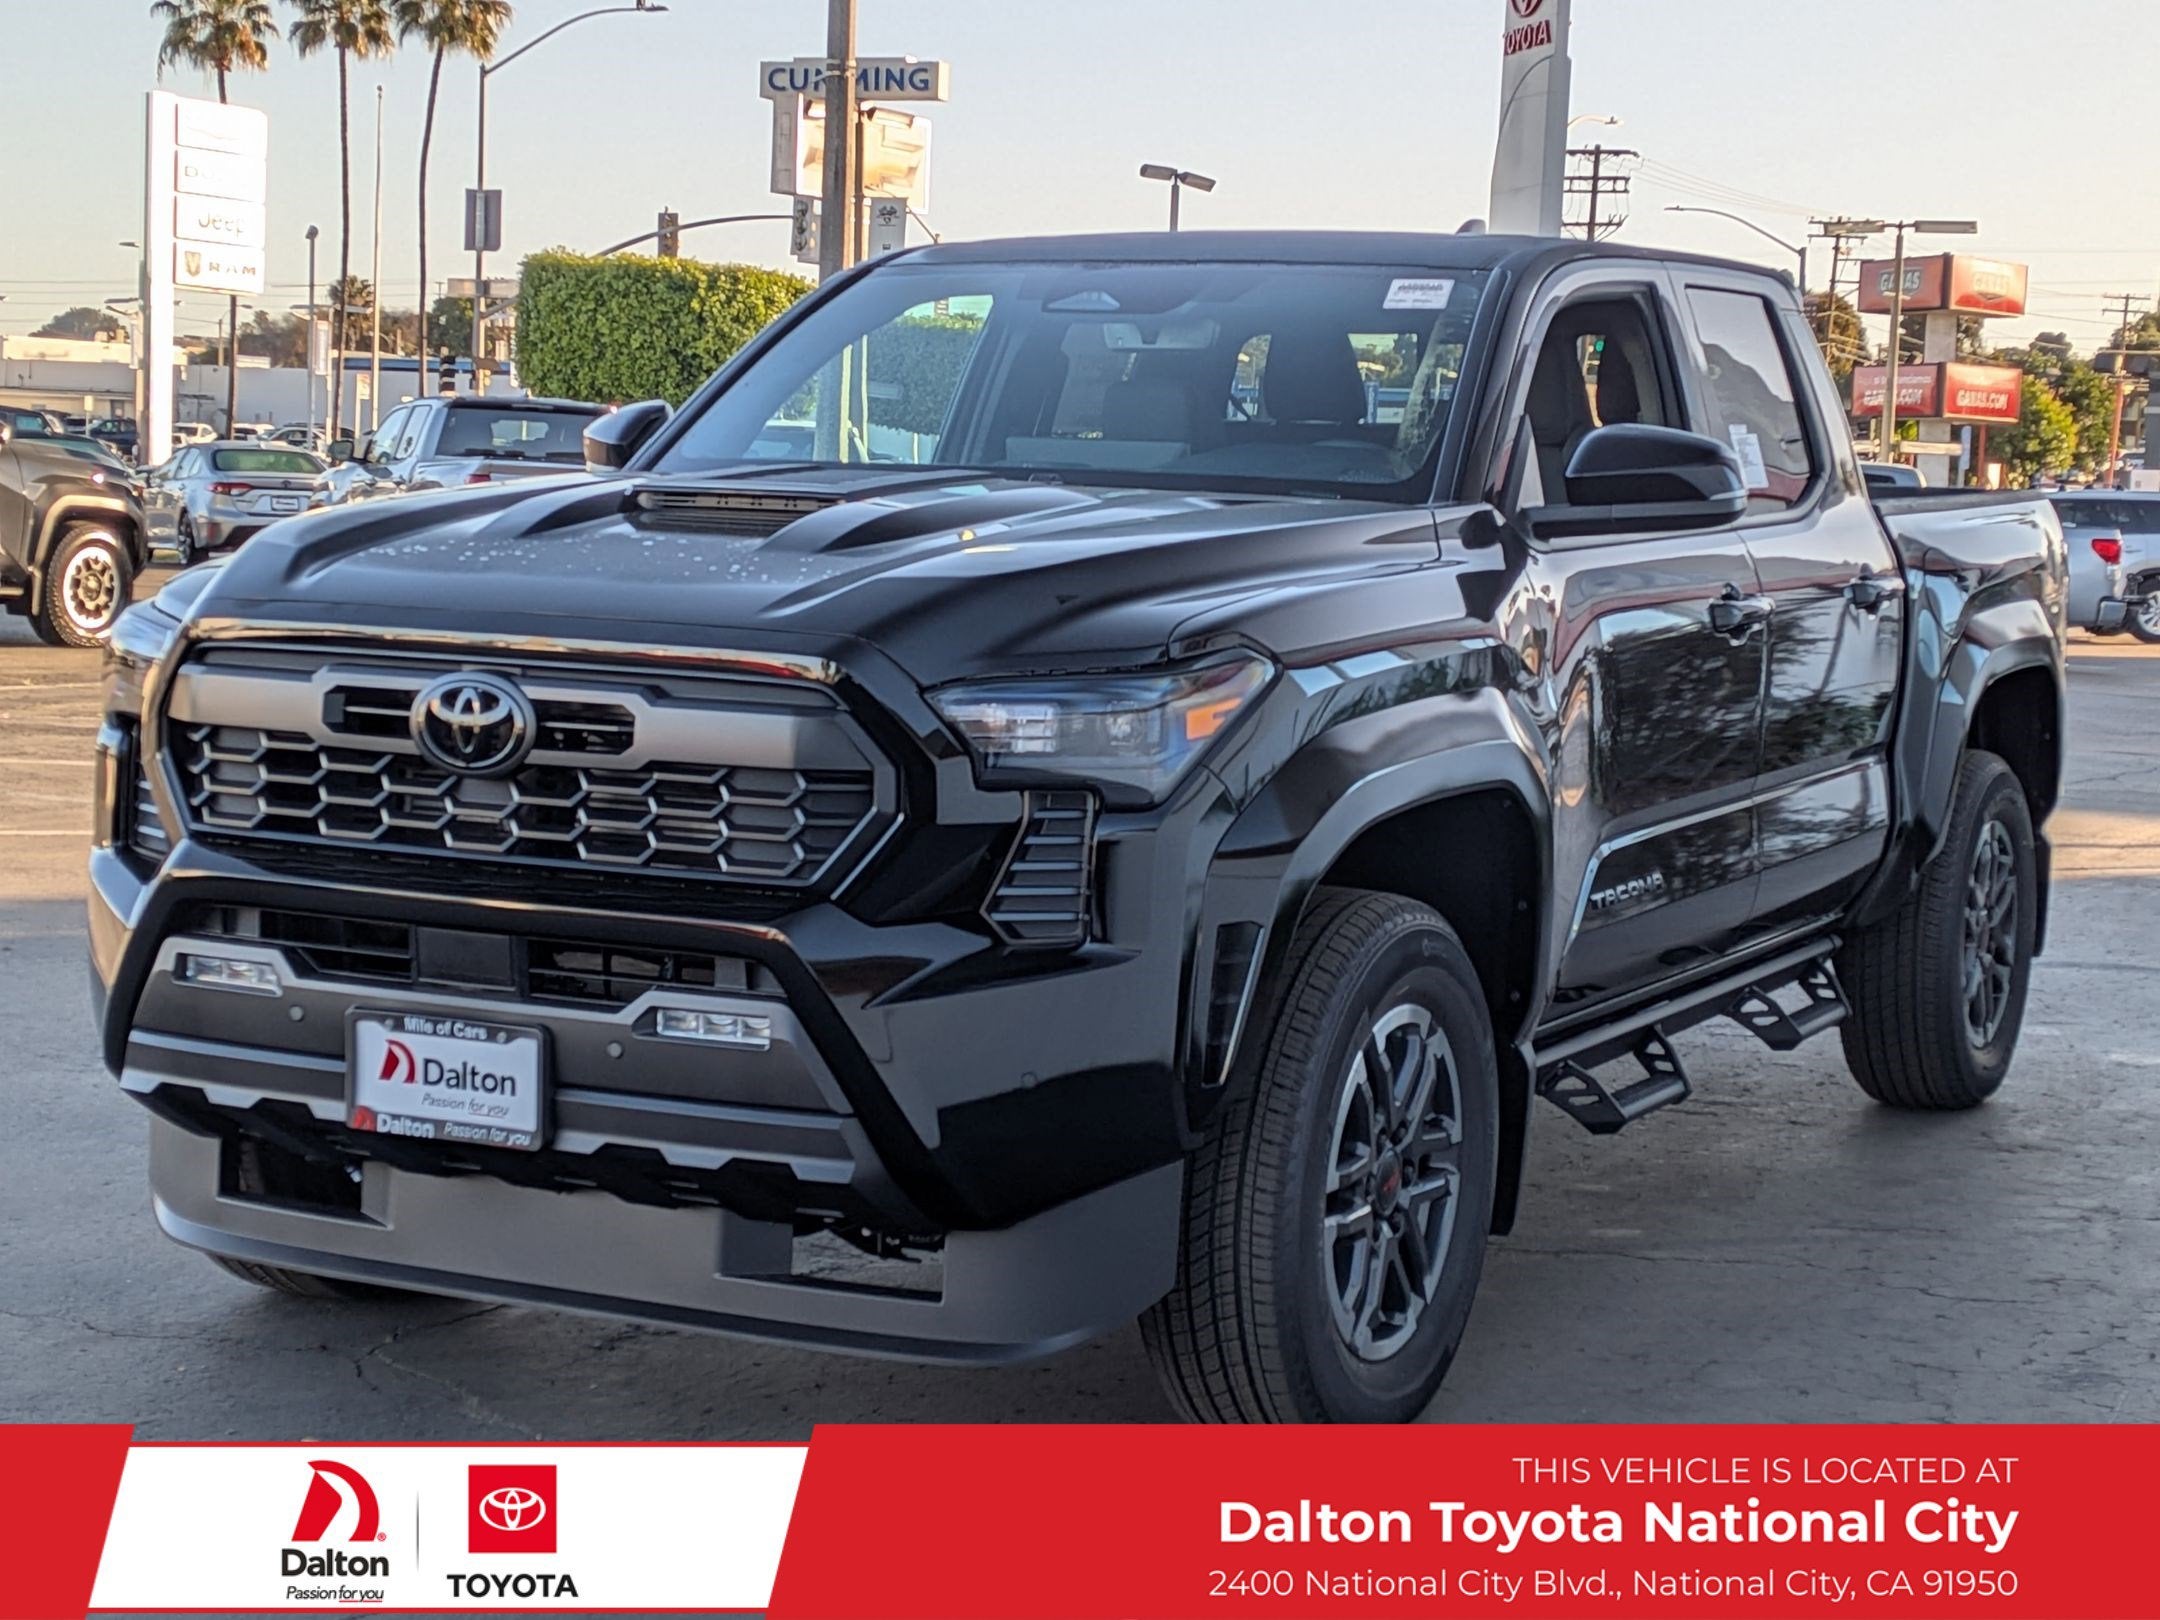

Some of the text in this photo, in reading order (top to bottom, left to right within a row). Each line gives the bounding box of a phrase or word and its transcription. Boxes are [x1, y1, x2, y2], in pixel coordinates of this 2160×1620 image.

[209, 261, 256, 276] RAM
[1590, 873, 1666, 909] TACOMA
[404, 1016, 488, 1040] Mile of Cars
[423, 1058, 516, 1096] Dalton
[421, 1093, 510, 1117] Passion for you
[376, 1114, 435, 1139] Dalton
[444, 1121, 532, 1146] Passion for you
